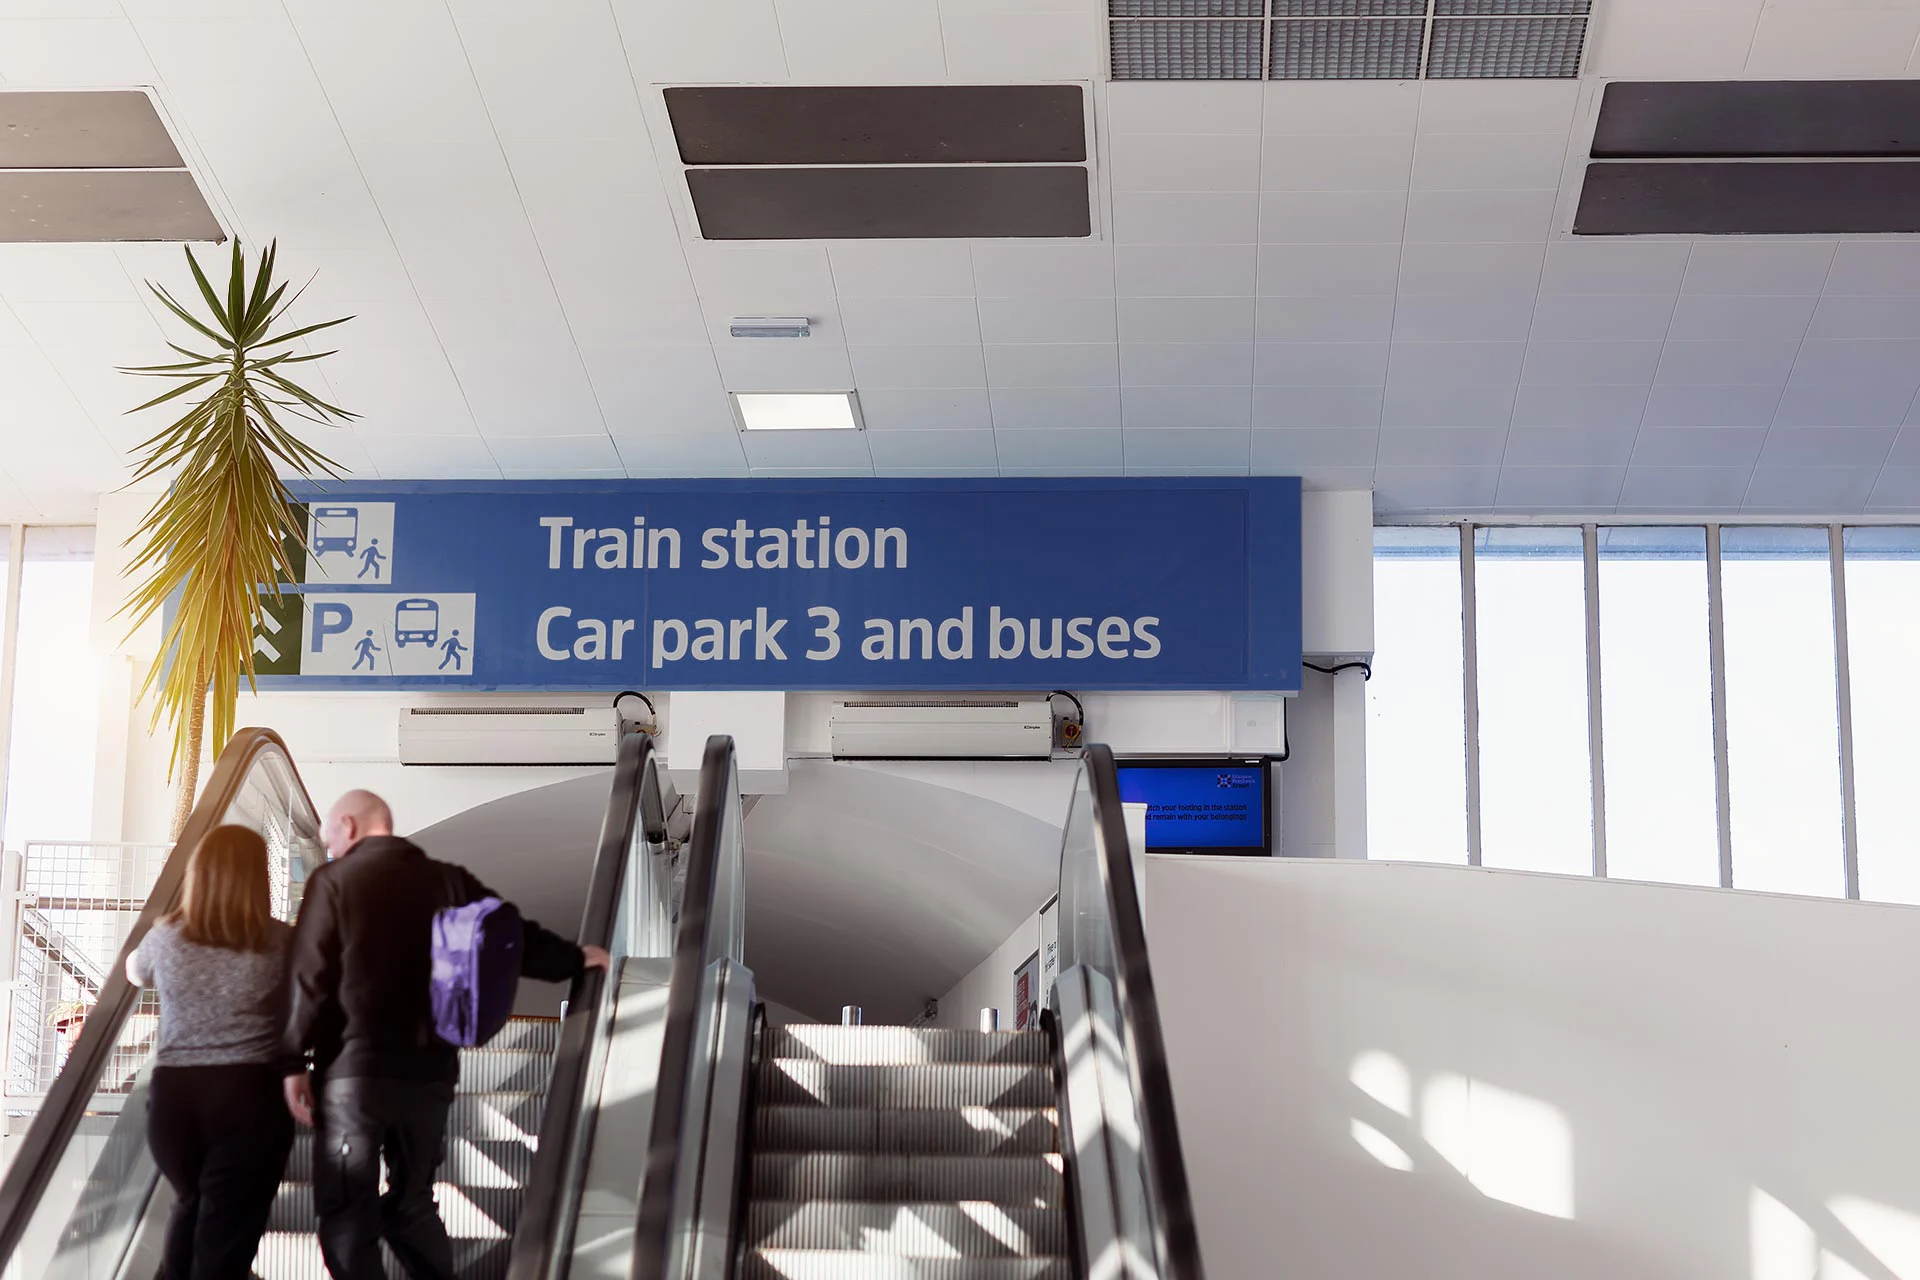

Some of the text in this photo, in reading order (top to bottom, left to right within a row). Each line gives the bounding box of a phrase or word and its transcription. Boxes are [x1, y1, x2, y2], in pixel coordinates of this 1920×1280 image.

[539, 516, 907, 569] Train station
[311, 602, 353, 653] P
[536, 606, 1161, 669] Car park 3 and buses
[1178, 804, 1202, 812] footing
[1210, 813, 1247, 821] belongings
